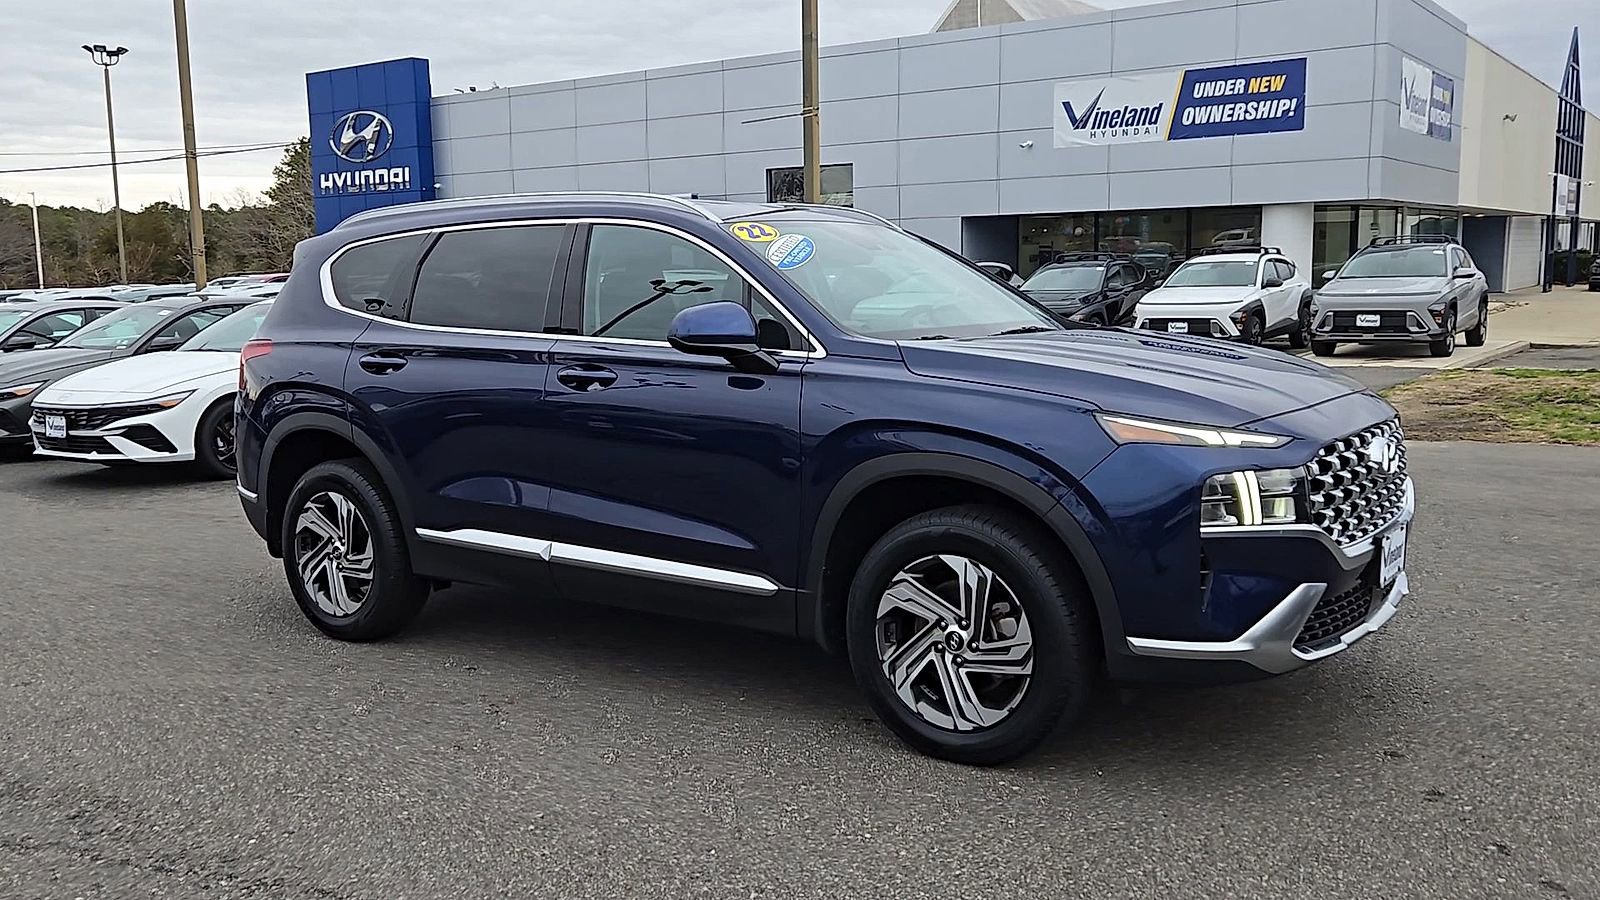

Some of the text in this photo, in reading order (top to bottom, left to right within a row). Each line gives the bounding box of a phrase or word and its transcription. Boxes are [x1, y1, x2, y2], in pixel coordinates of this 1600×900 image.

[1193, 74, 1287, 99] UNDER NEW
[1061, 86, 1164, 130] Vineland
[1181, 98, 1298, 126] OWNERSHIP!
[1089, 125, 1160, 139] HYUNDAI
[320, 166, 410, 194] HYUNDAI
[737, 223, 774, 239] 22
